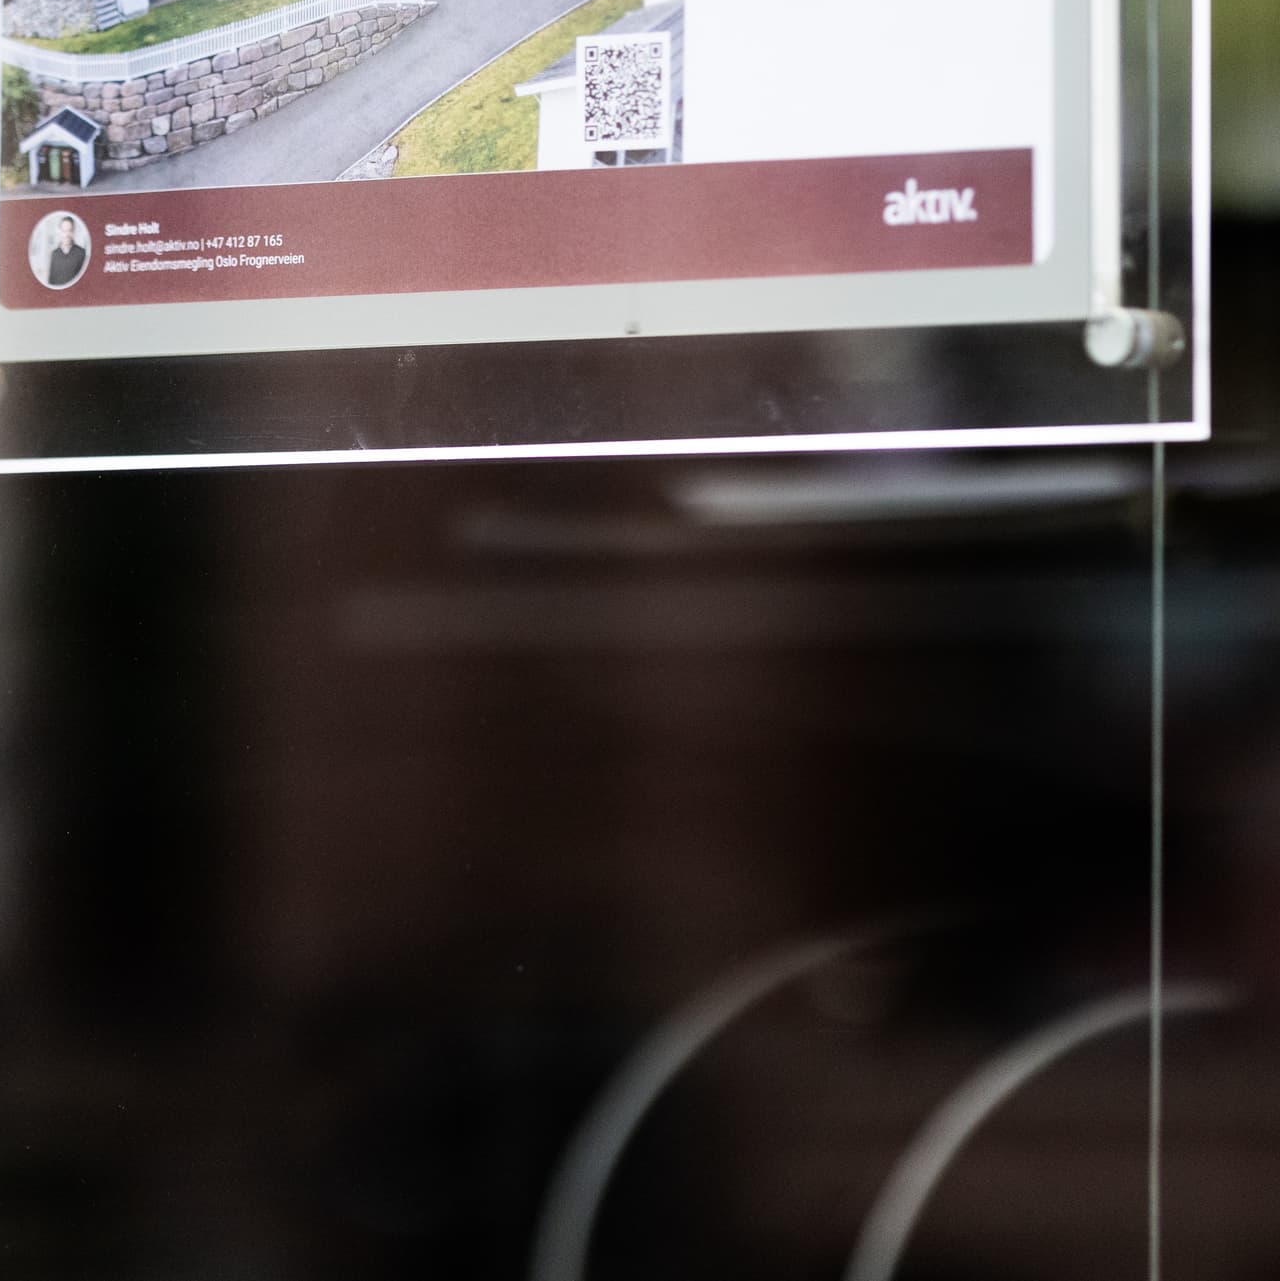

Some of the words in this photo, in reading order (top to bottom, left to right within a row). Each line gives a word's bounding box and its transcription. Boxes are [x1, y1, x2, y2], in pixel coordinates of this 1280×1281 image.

[206, 236, 225, 249] +47
[226, 235, 246, 248] 412
[247, 235, 261, 248] 87
[263, 233, 283, 247] 165
[215, 255, 238, 268] Oslo
[239, 253, 305, 269] Frognerveien
